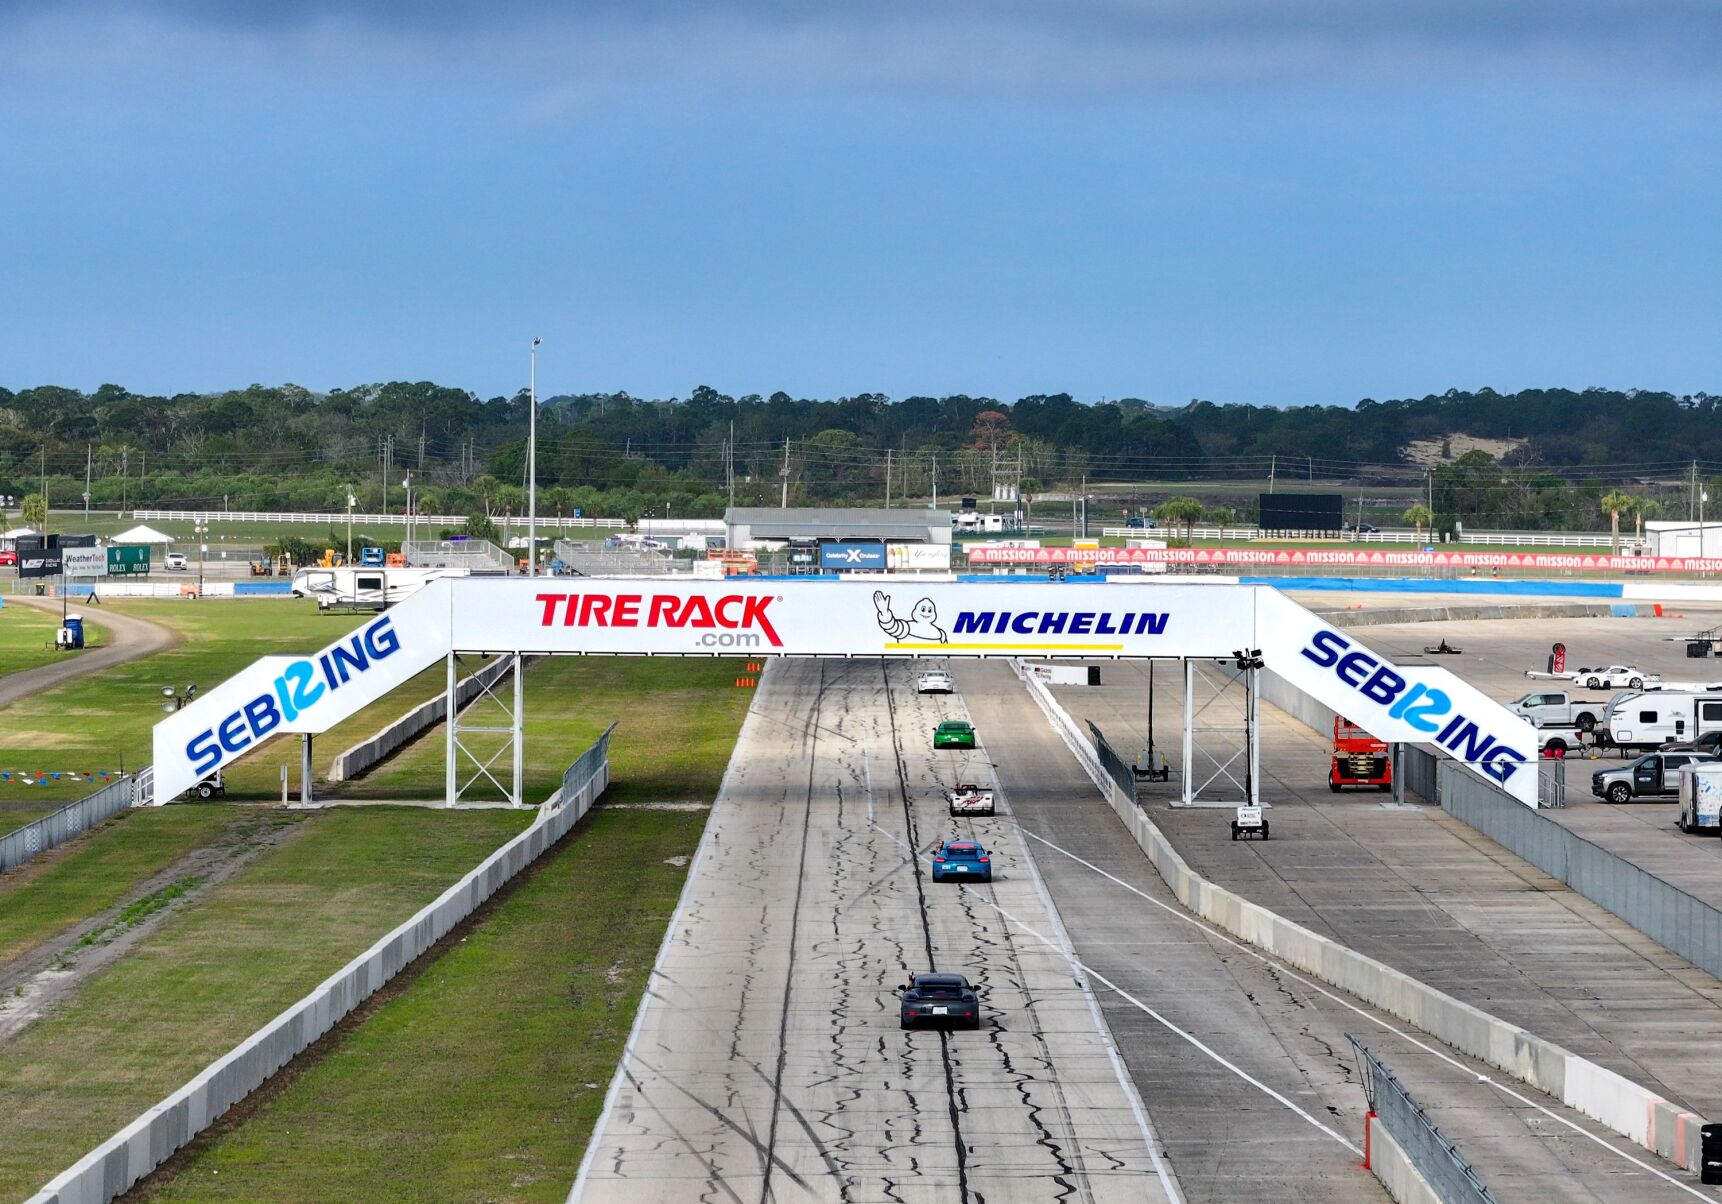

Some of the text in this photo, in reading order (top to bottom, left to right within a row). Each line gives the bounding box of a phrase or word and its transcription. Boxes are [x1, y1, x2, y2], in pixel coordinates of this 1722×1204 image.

[65, 554, 105, 563] WeatherTech
[109, 563, 126, 572] ROLEX
[133, 563, 148, 572] ROLEX
[536, 594, 784, 647] TIRE RACK
[952, 611, 1170, 635] MICHELIN
[695, 633, 760, 647] .com
